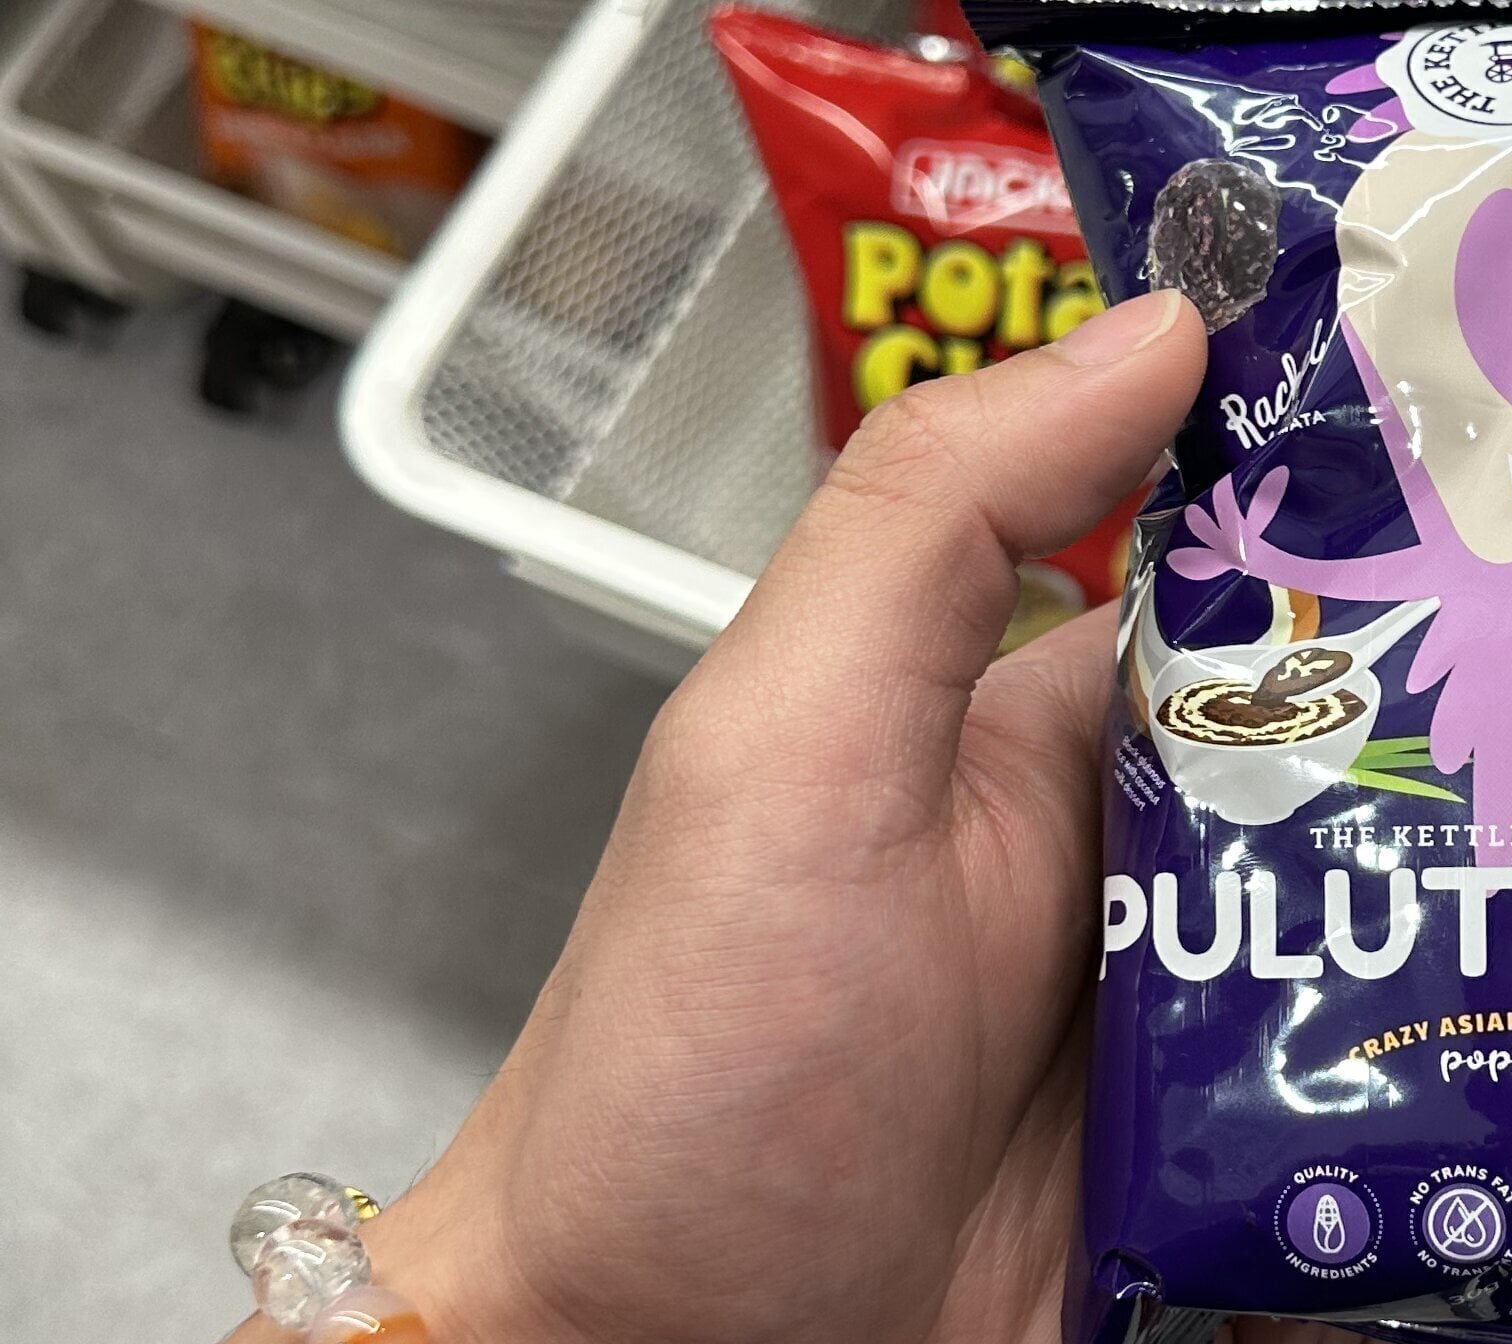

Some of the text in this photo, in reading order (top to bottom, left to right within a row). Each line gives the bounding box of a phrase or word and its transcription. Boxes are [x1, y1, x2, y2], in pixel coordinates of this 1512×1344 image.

[1430, 75, 1497, 114] THE
[1309, 824, 1378, 850] THE
[1348, 1021, 1430, 1061] CRAZY
[1293, 1164, 1360, 1186] QUALITY
[1409, 1181, 1431, 1205] NO
[1430, 1164, 1488, 1184] TRANS
[1285, 1252, 1378, 1280] INGREDIENTS
[1417, 1249, 1438, 1269] NO
